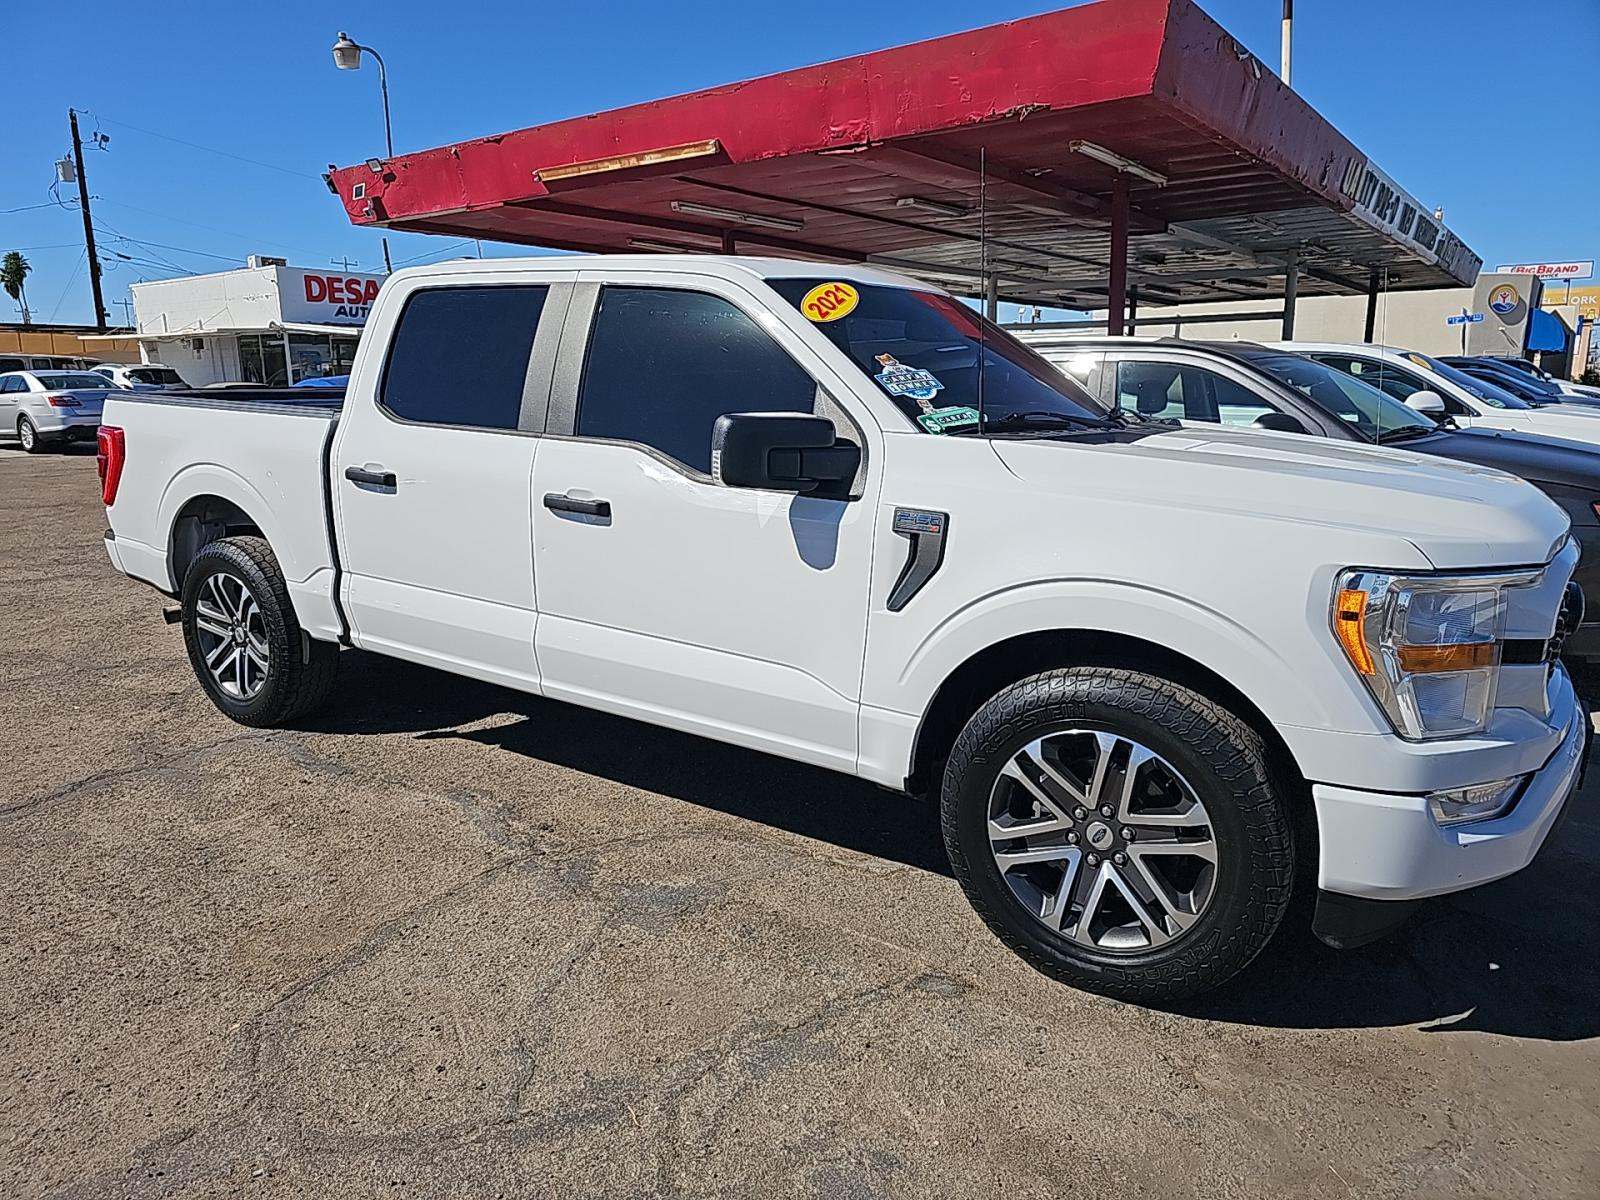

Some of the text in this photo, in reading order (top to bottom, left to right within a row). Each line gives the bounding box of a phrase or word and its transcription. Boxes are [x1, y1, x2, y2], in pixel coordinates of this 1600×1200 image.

[1536, 265, 1579, 274] BRAND
[808, 284, 853, 319] 2021
[334, 305, 371, 318] AUT
[881, 370, 934, 384] CARFAX
